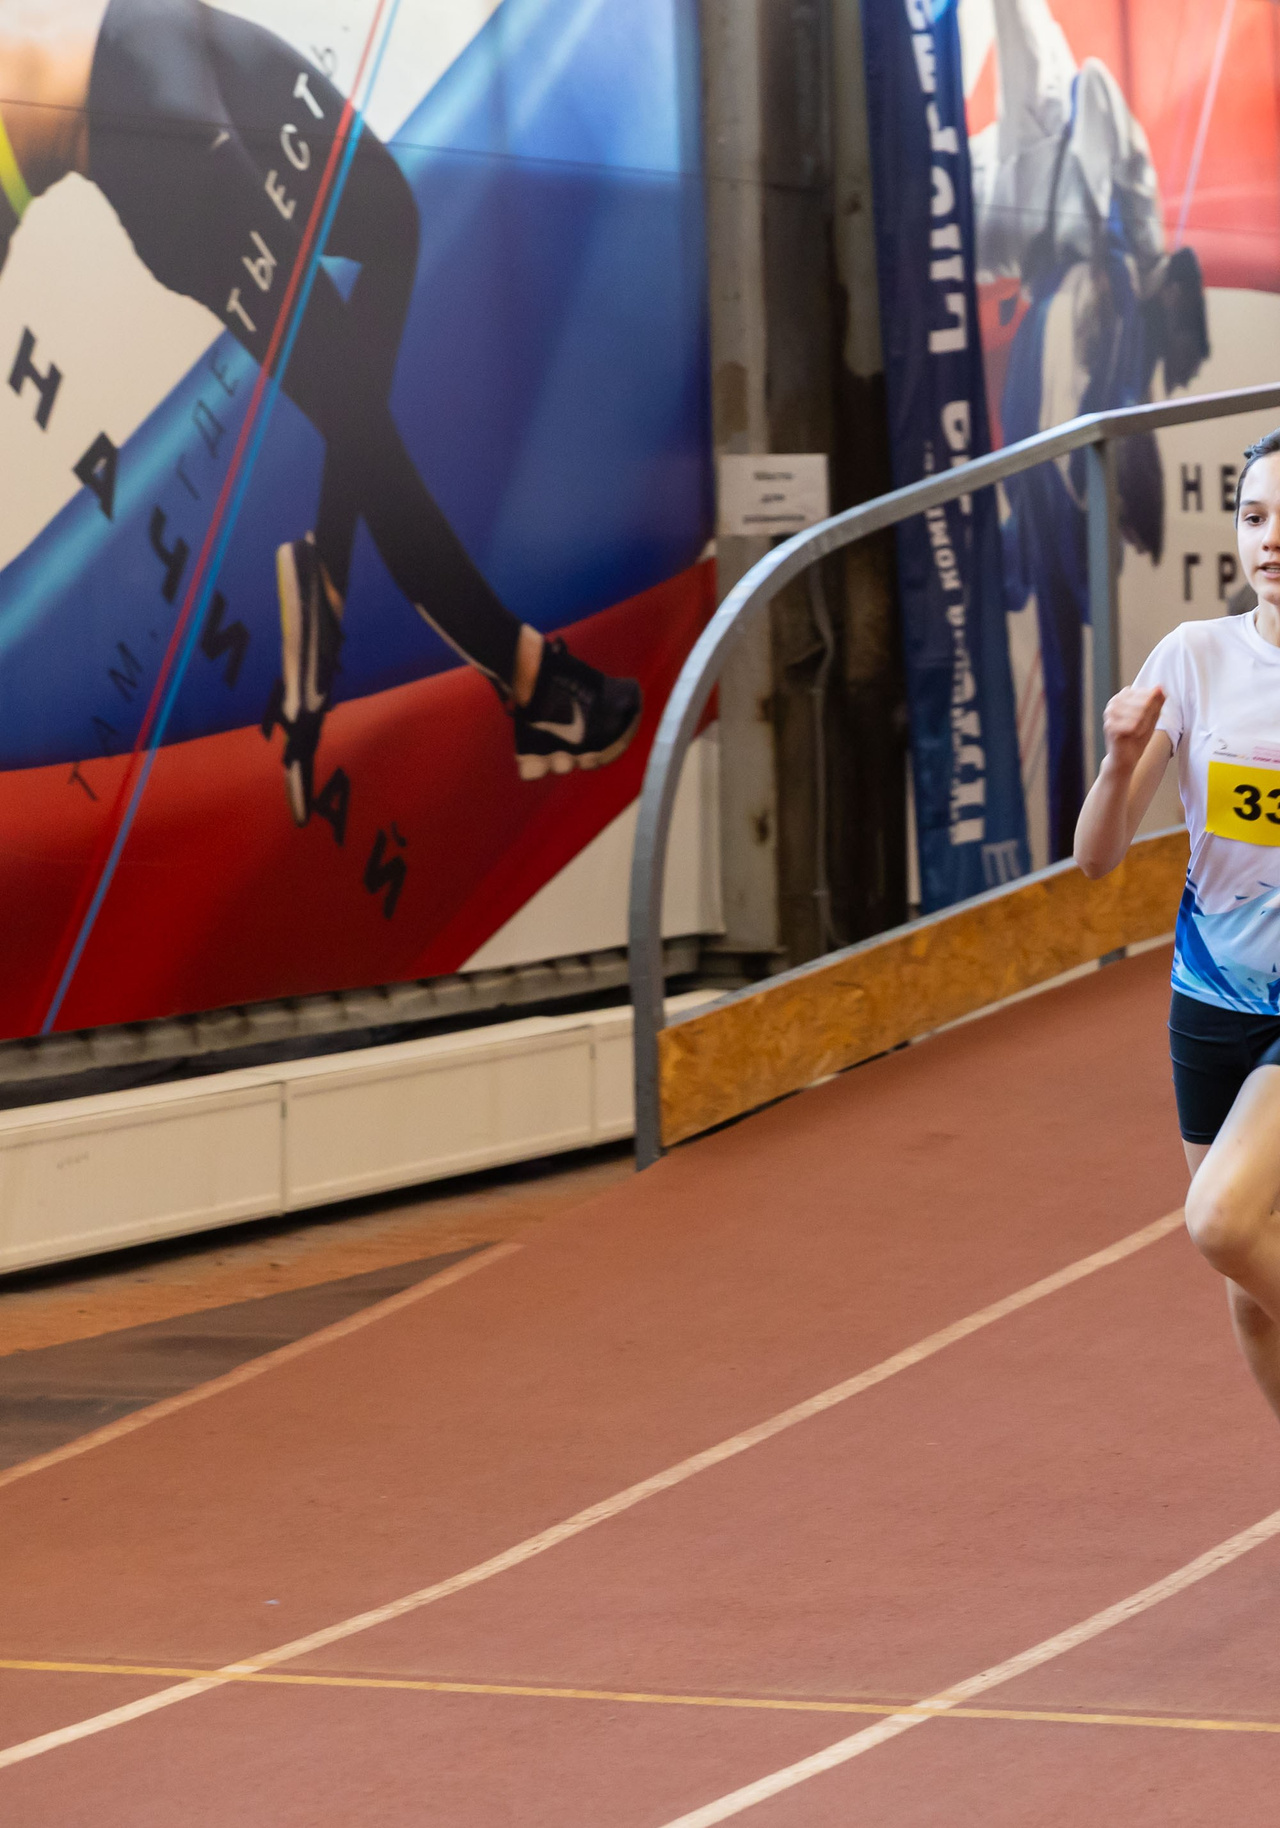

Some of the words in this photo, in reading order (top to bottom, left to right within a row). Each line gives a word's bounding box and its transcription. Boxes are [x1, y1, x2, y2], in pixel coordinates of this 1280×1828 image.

[226, 230, 278, 332] ТЫ
[7, 325, 407, 921] НАЧИАЙ
[1184, 552, 1238, 602] ГР
